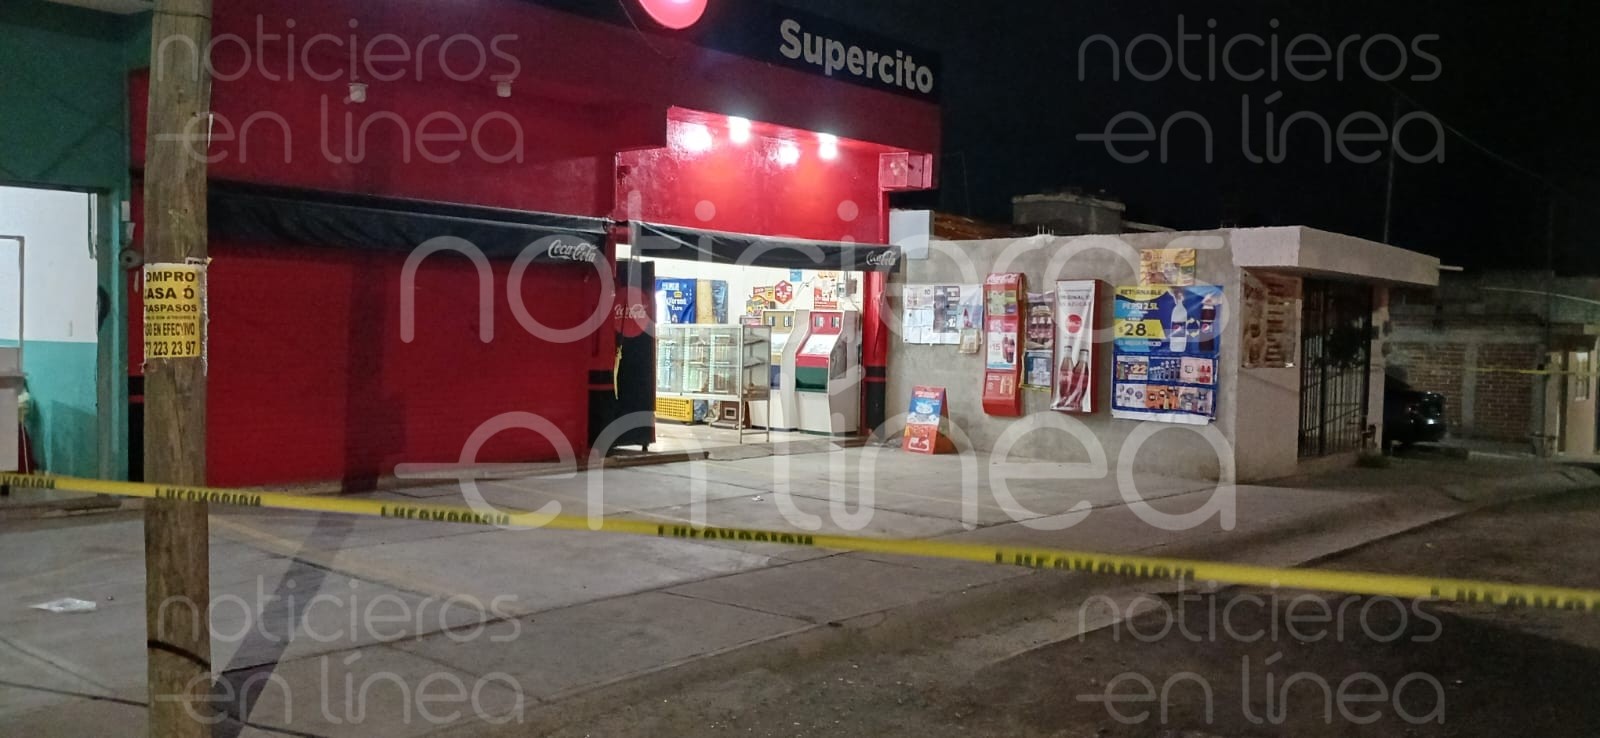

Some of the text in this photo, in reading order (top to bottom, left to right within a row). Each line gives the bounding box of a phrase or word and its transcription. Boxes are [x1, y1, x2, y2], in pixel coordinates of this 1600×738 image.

[779, 18, 934, 94] Supercito
[146, 271, 195, 282] OMPRO
[153, 341, 168, 356] 223
[171, 341, 183, 356] 23
[185, 340, 196, 355] 97
